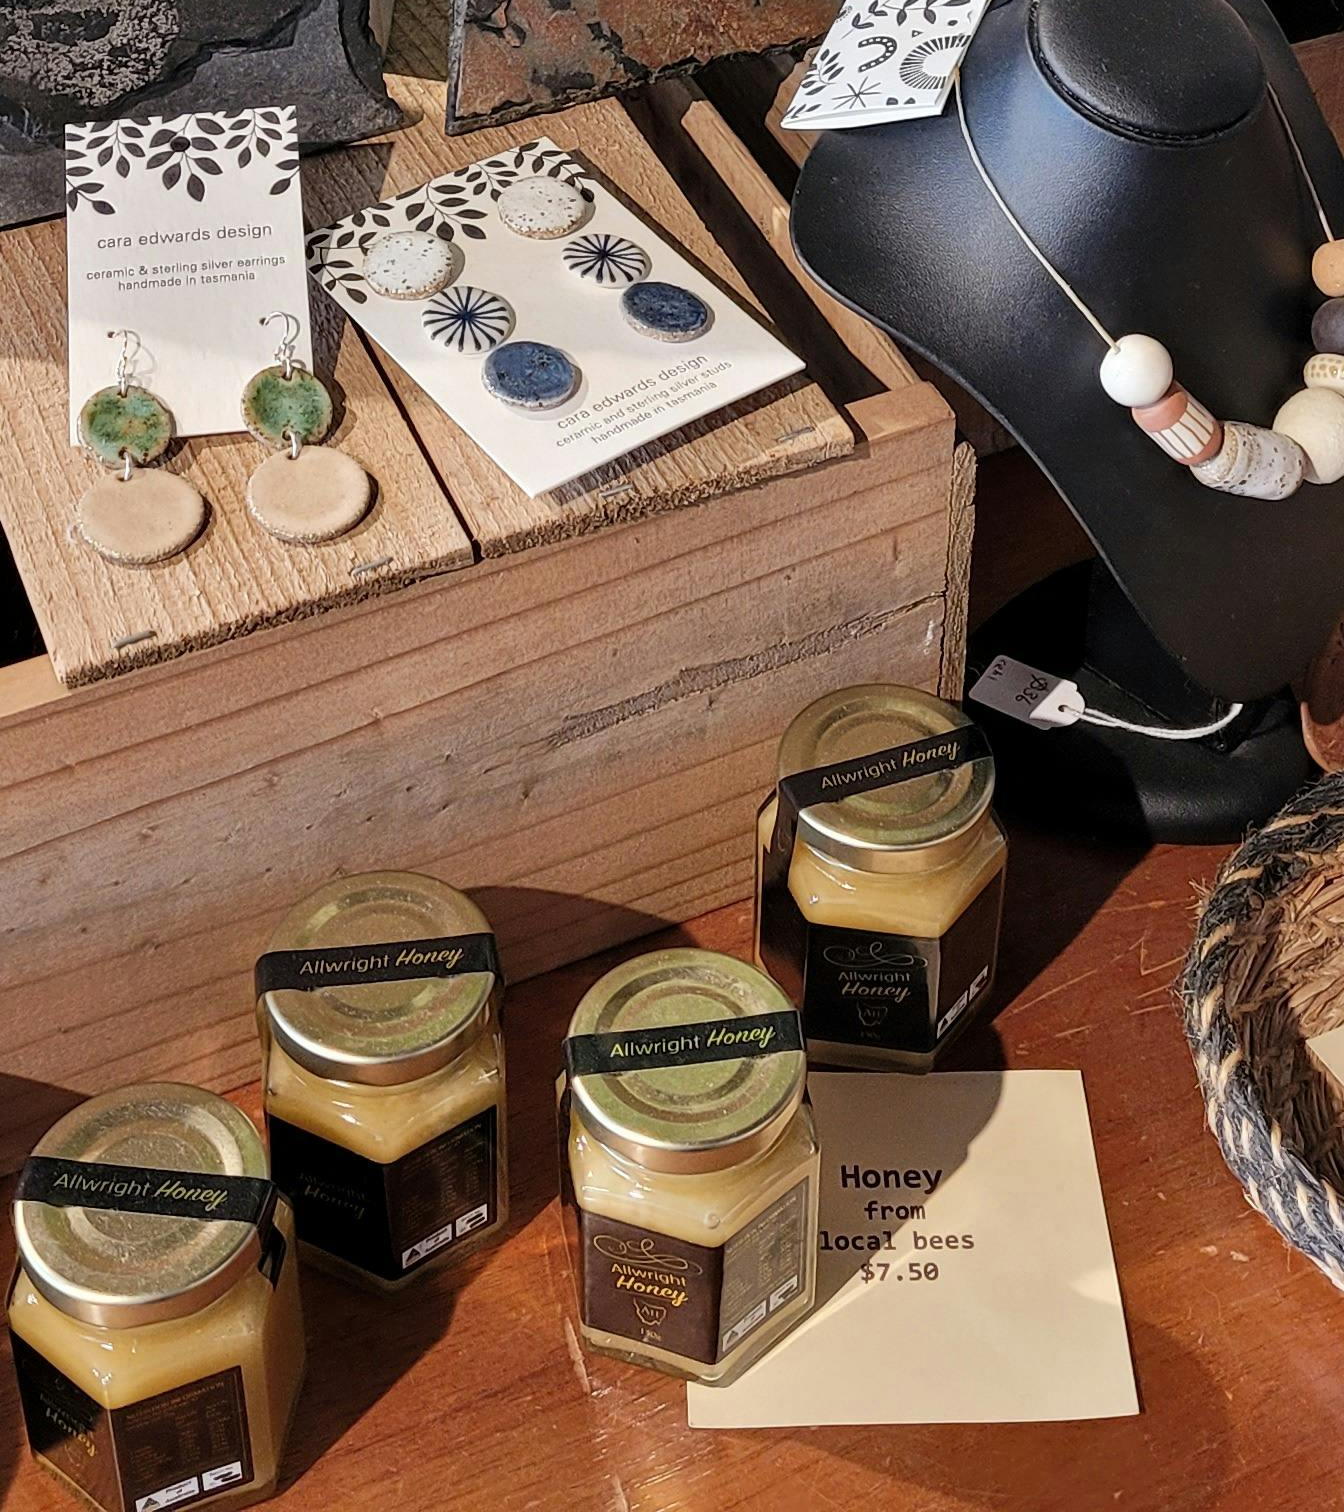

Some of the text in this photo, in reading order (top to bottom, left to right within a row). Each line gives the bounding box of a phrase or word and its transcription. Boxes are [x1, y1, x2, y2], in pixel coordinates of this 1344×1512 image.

[97, 224, 272, 249] cara edwards design
[86, 255, 286, 281] ceramic & sterling silver earrings
[118, 270, 256, 292] handmade in tasmania
[556, 362, 733, 447] ceramic and sterling silver studs
[557, 356, 709, 429] cara edwards design
[592, 382, 718, 444] handmade in tasmania
[1015, 673, 1048, 706] $36
[821, 742, 960, 789] Allwright Honey
[299, 946, 465, 975] Allwright Honey
[838, 971, 912, 1003] Allwright Honey
[609, 1024, 776, 1059] Allwright Honey
[53, 1172, 228, 1210] Allwright Honey
[841, 1165, 942, 1194] Honey
[864, 1201, 925, 1220] from
[820, 1231, 974, 1250] local bees
[611, 1263, 689, 1307] Allwright Honey
[861, 1262, 939, 1283] $7.50
